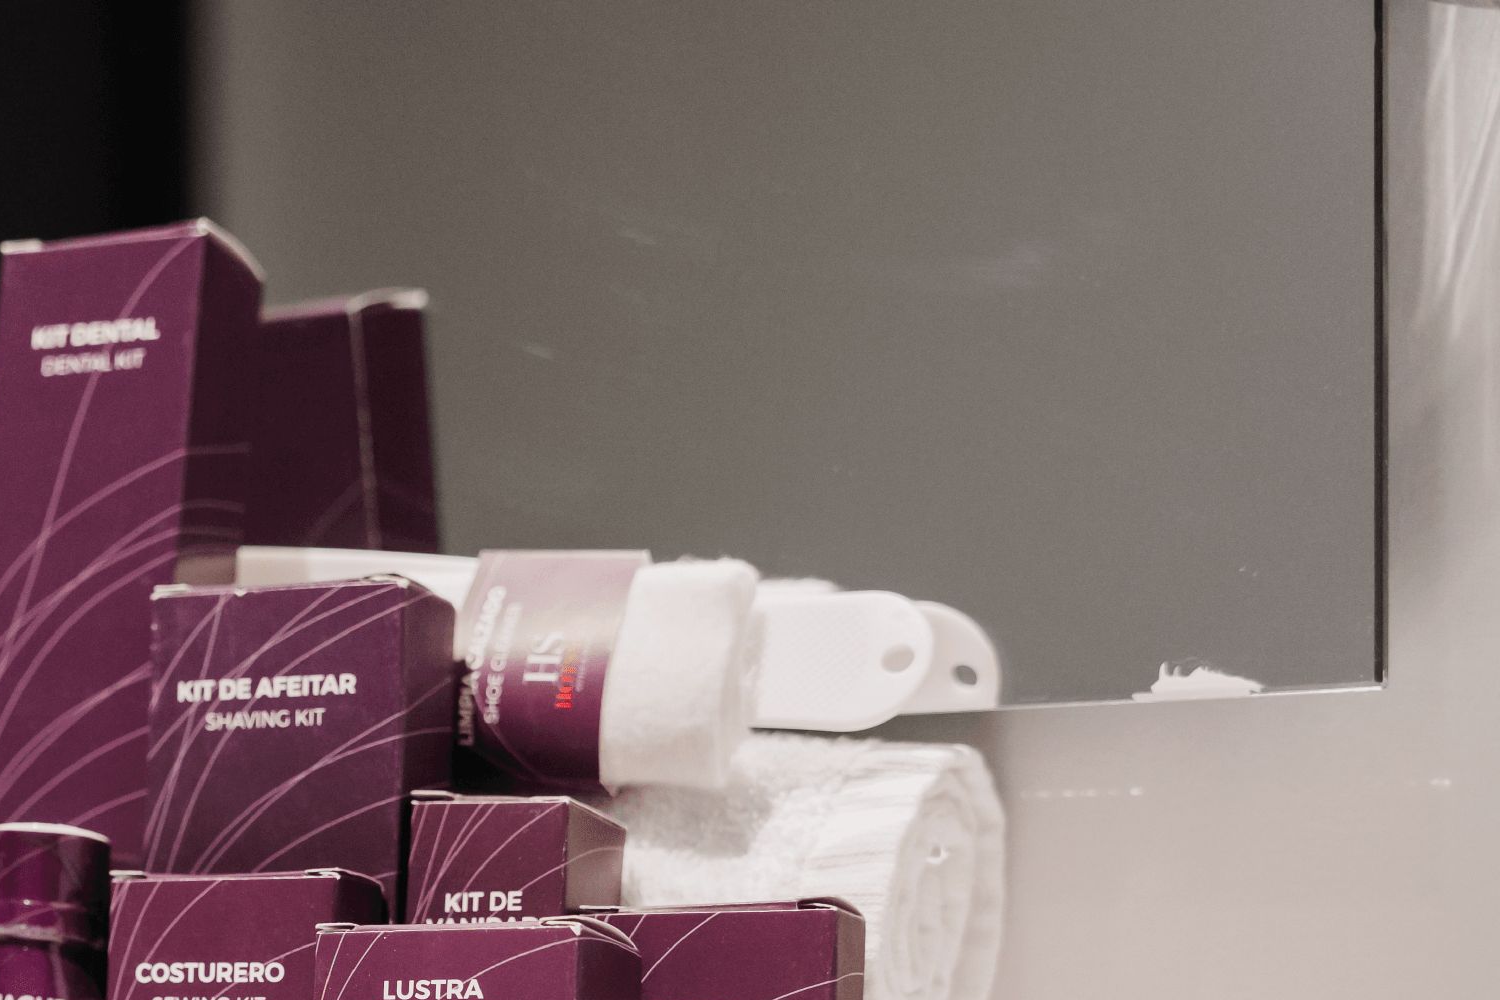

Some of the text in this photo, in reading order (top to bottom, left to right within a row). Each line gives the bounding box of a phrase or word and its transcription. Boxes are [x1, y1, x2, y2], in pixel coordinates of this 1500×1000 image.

[31, 316, 161, 350] KIT DENTAL
[40, 348, 147, 377] DENTAL KIT
[177, 673, 357, 703] KIT DE AFEITAR
[205, 707, 327, 731] SHAVING KIT
[444, 890, 523, 913] KIT DE
[135, 961, 285, 984] COSTURERO
[383, 978, 484, 1000] LUSTRA
